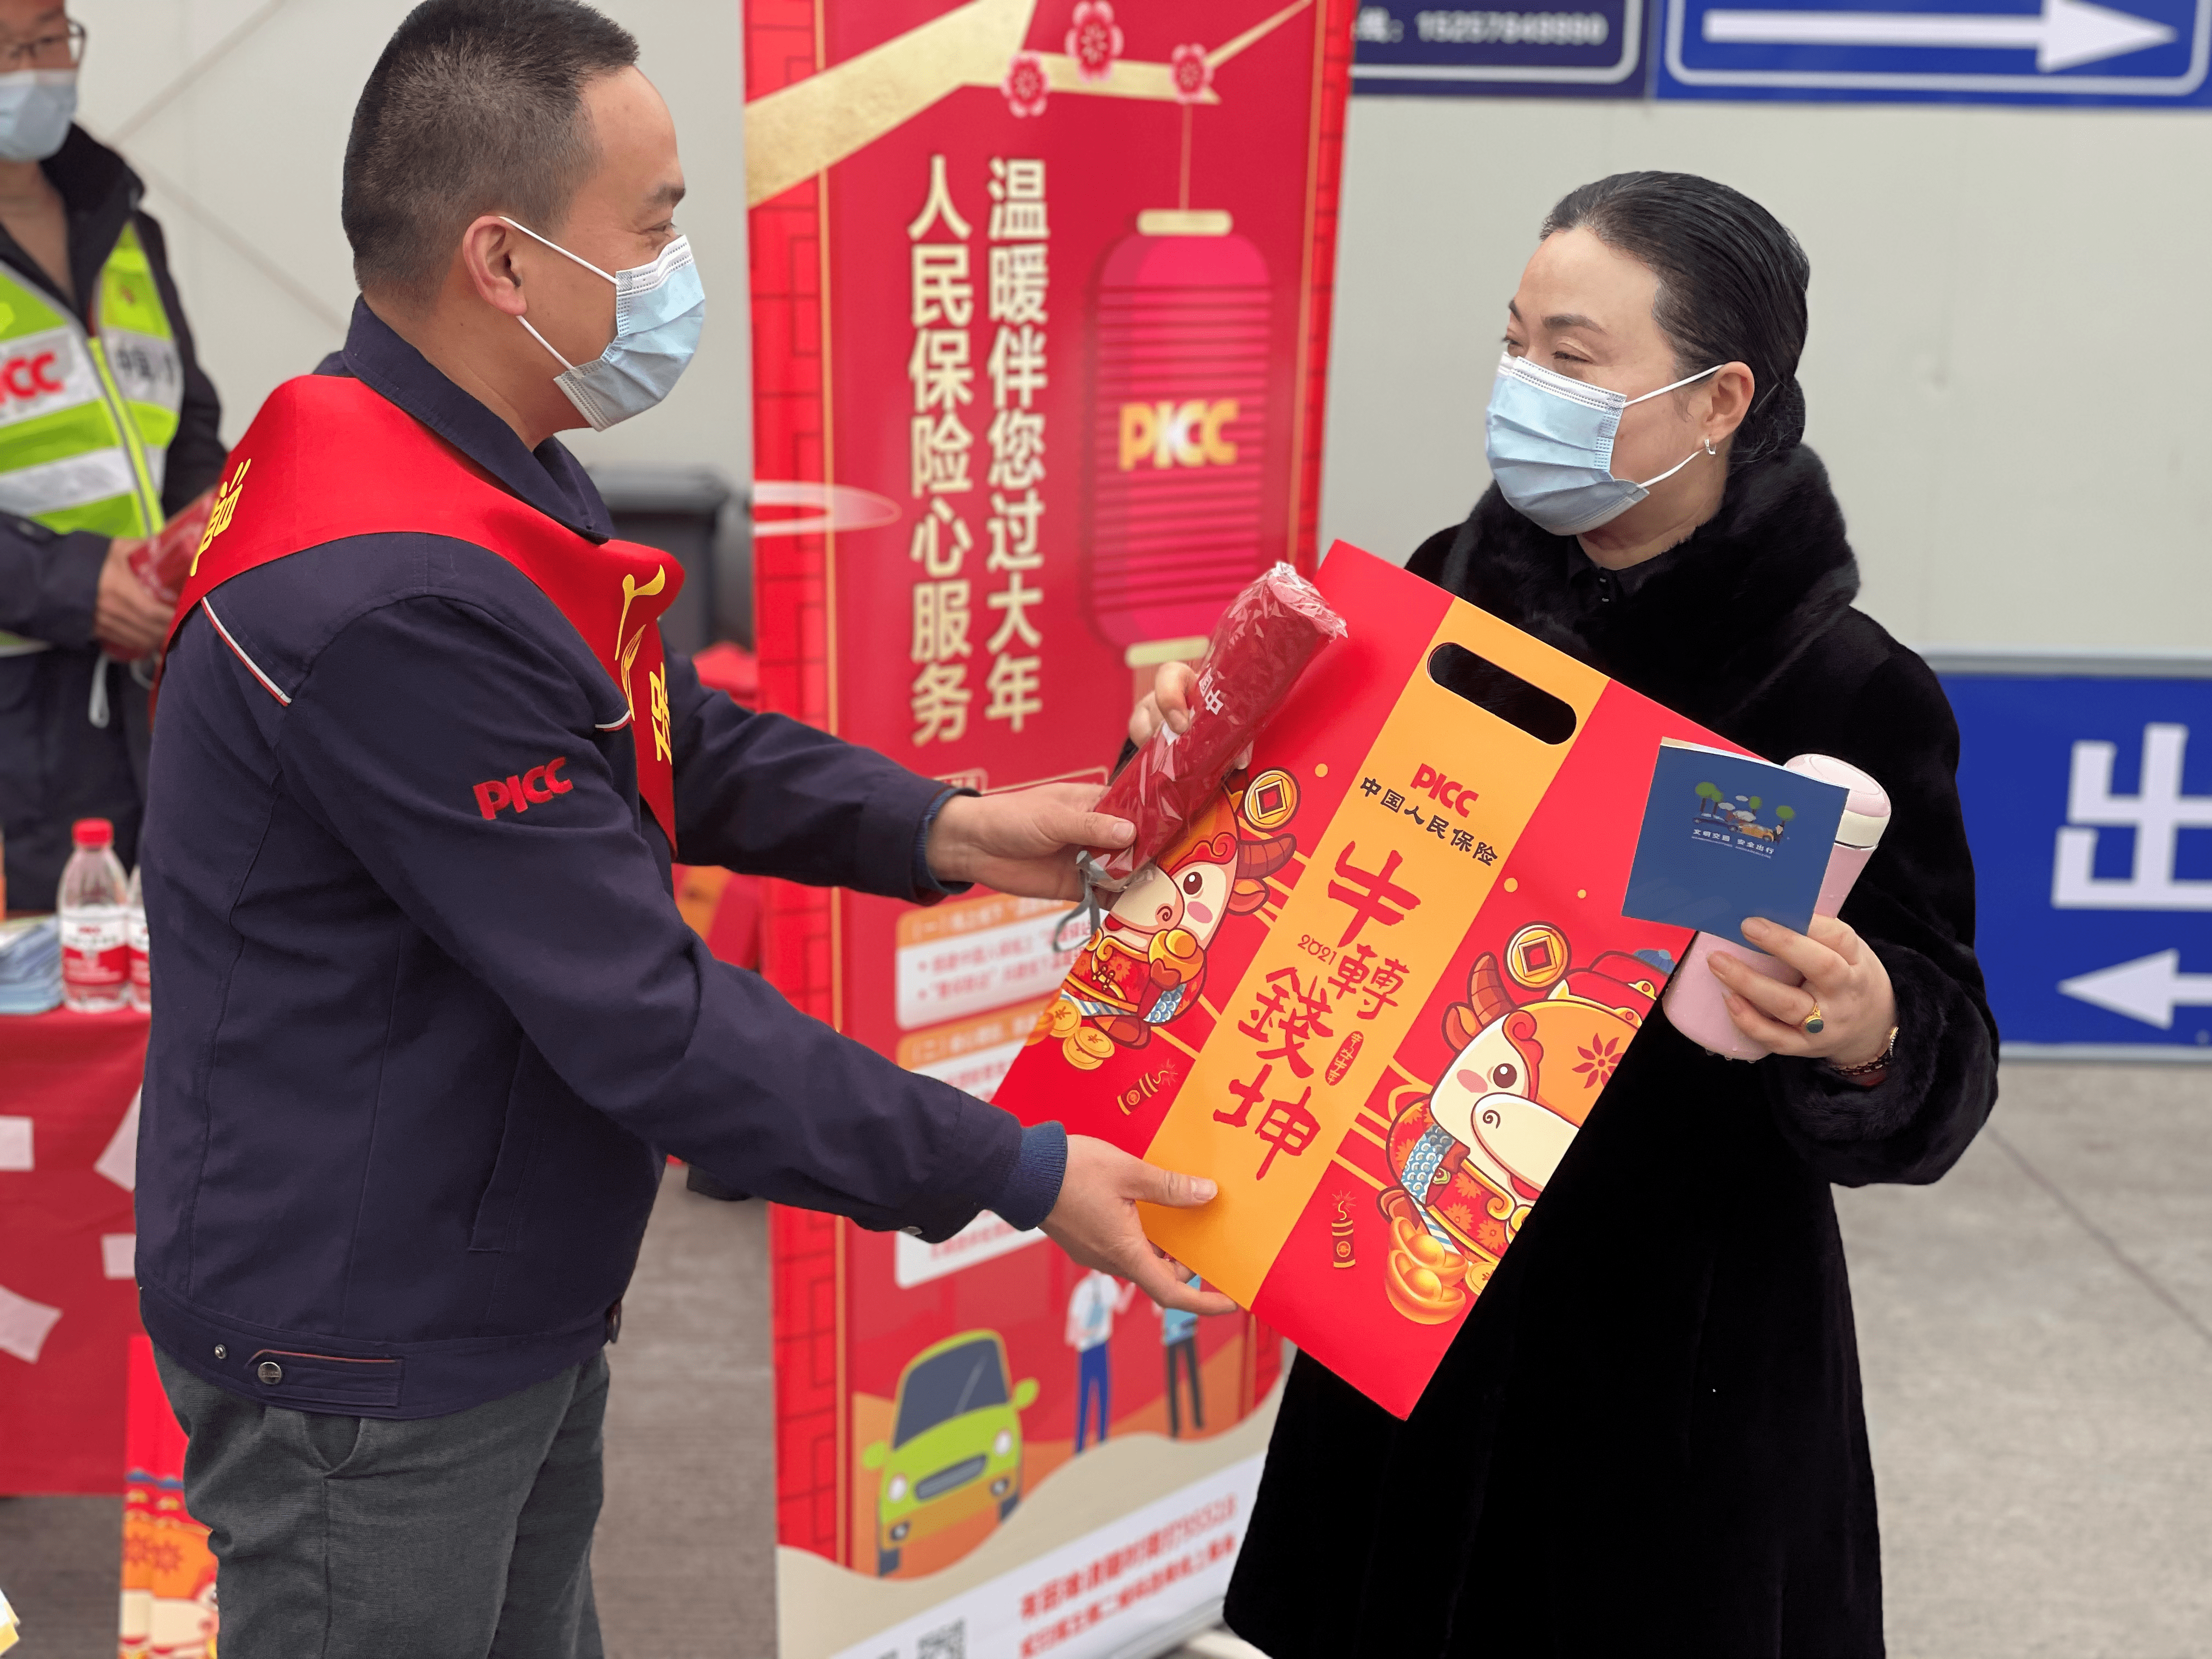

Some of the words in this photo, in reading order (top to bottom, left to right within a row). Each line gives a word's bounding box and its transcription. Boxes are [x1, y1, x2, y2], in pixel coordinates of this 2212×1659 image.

[908, 154, 973, 748] 人民保险心服务
[985, 157, 1050, 732] 温暖伴您过大年
[1119, 399, 1238, 470] PICC
[473, 757, 573, 820] PICC
[1360, 777, 1498, 866] 中国人民保险
[1410, 763, 1480, 818] PICC
[1297, 934, 1338, 965] 2021
